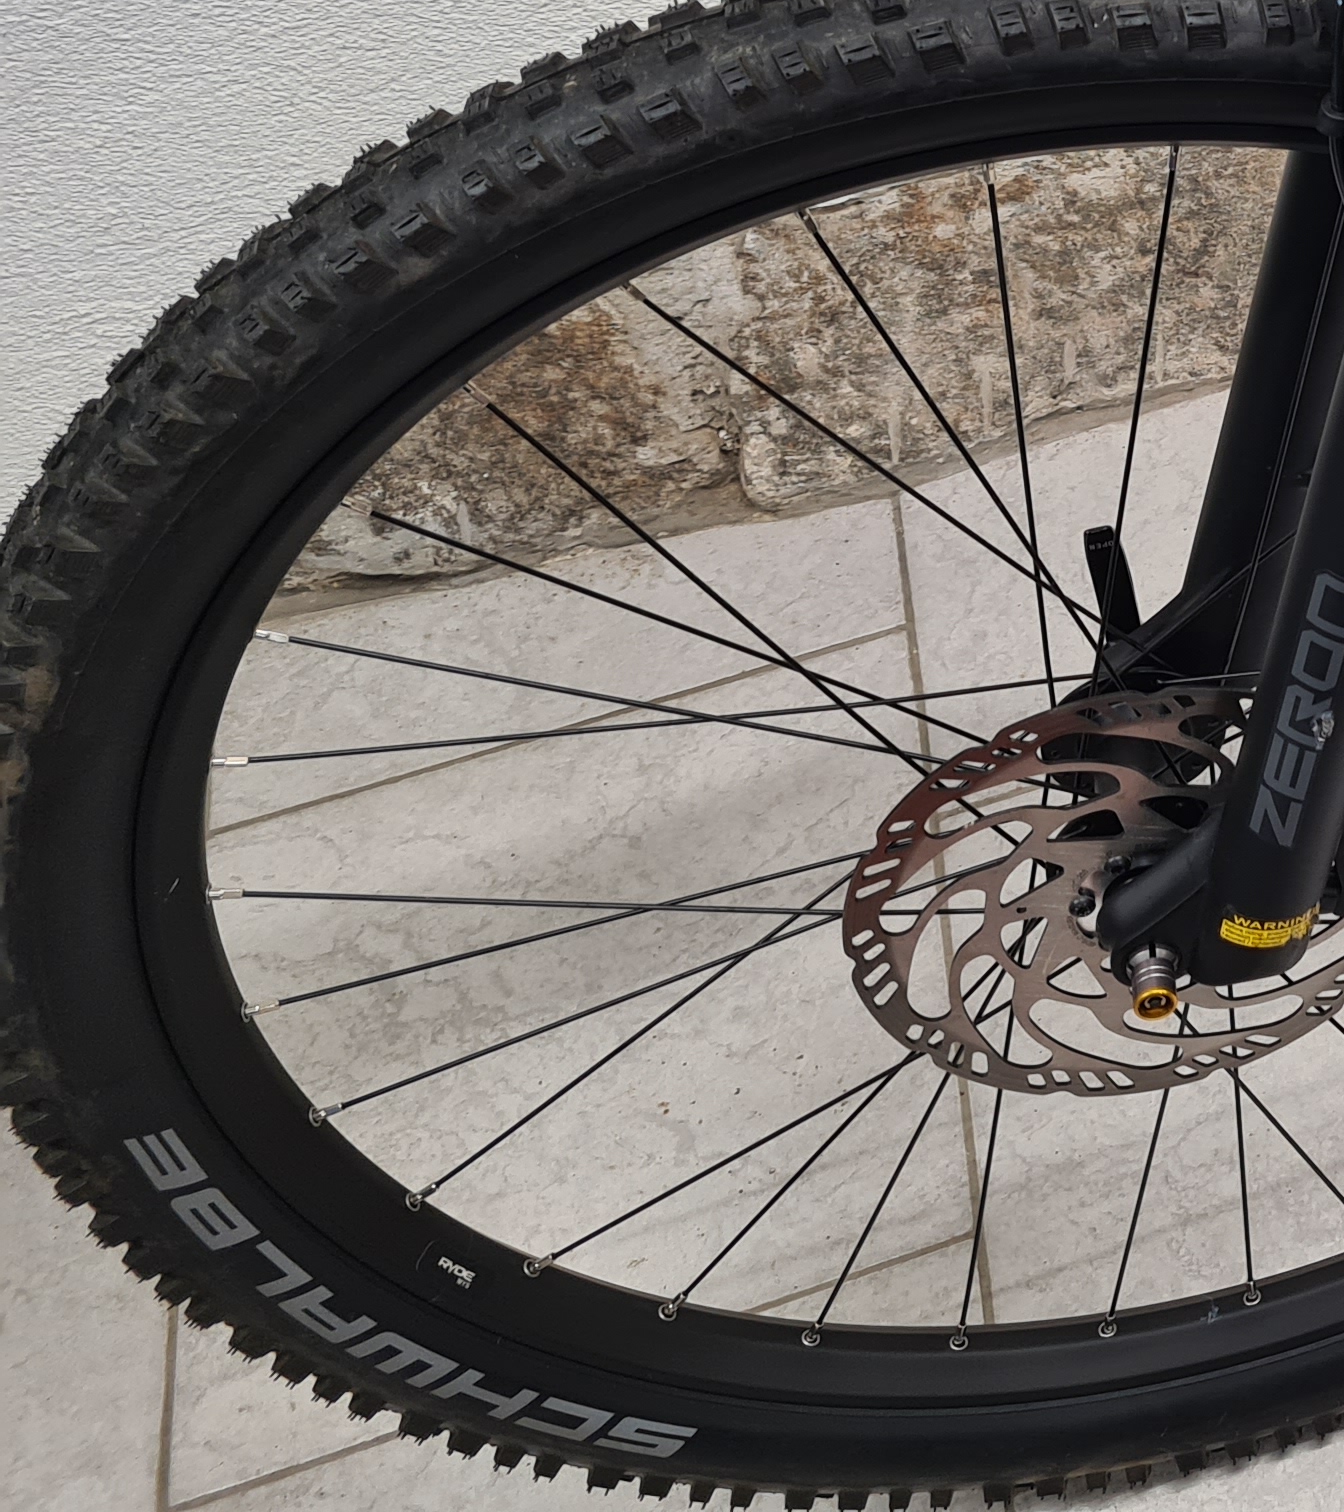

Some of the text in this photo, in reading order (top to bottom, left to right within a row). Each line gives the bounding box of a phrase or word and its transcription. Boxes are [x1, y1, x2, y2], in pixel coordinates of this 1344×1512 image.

[1089, 540, 1114, 551] OPEN
[437, 1255, 477, 1282] RYDE
[123, 1127, 698, 1460] SCHWALBE
